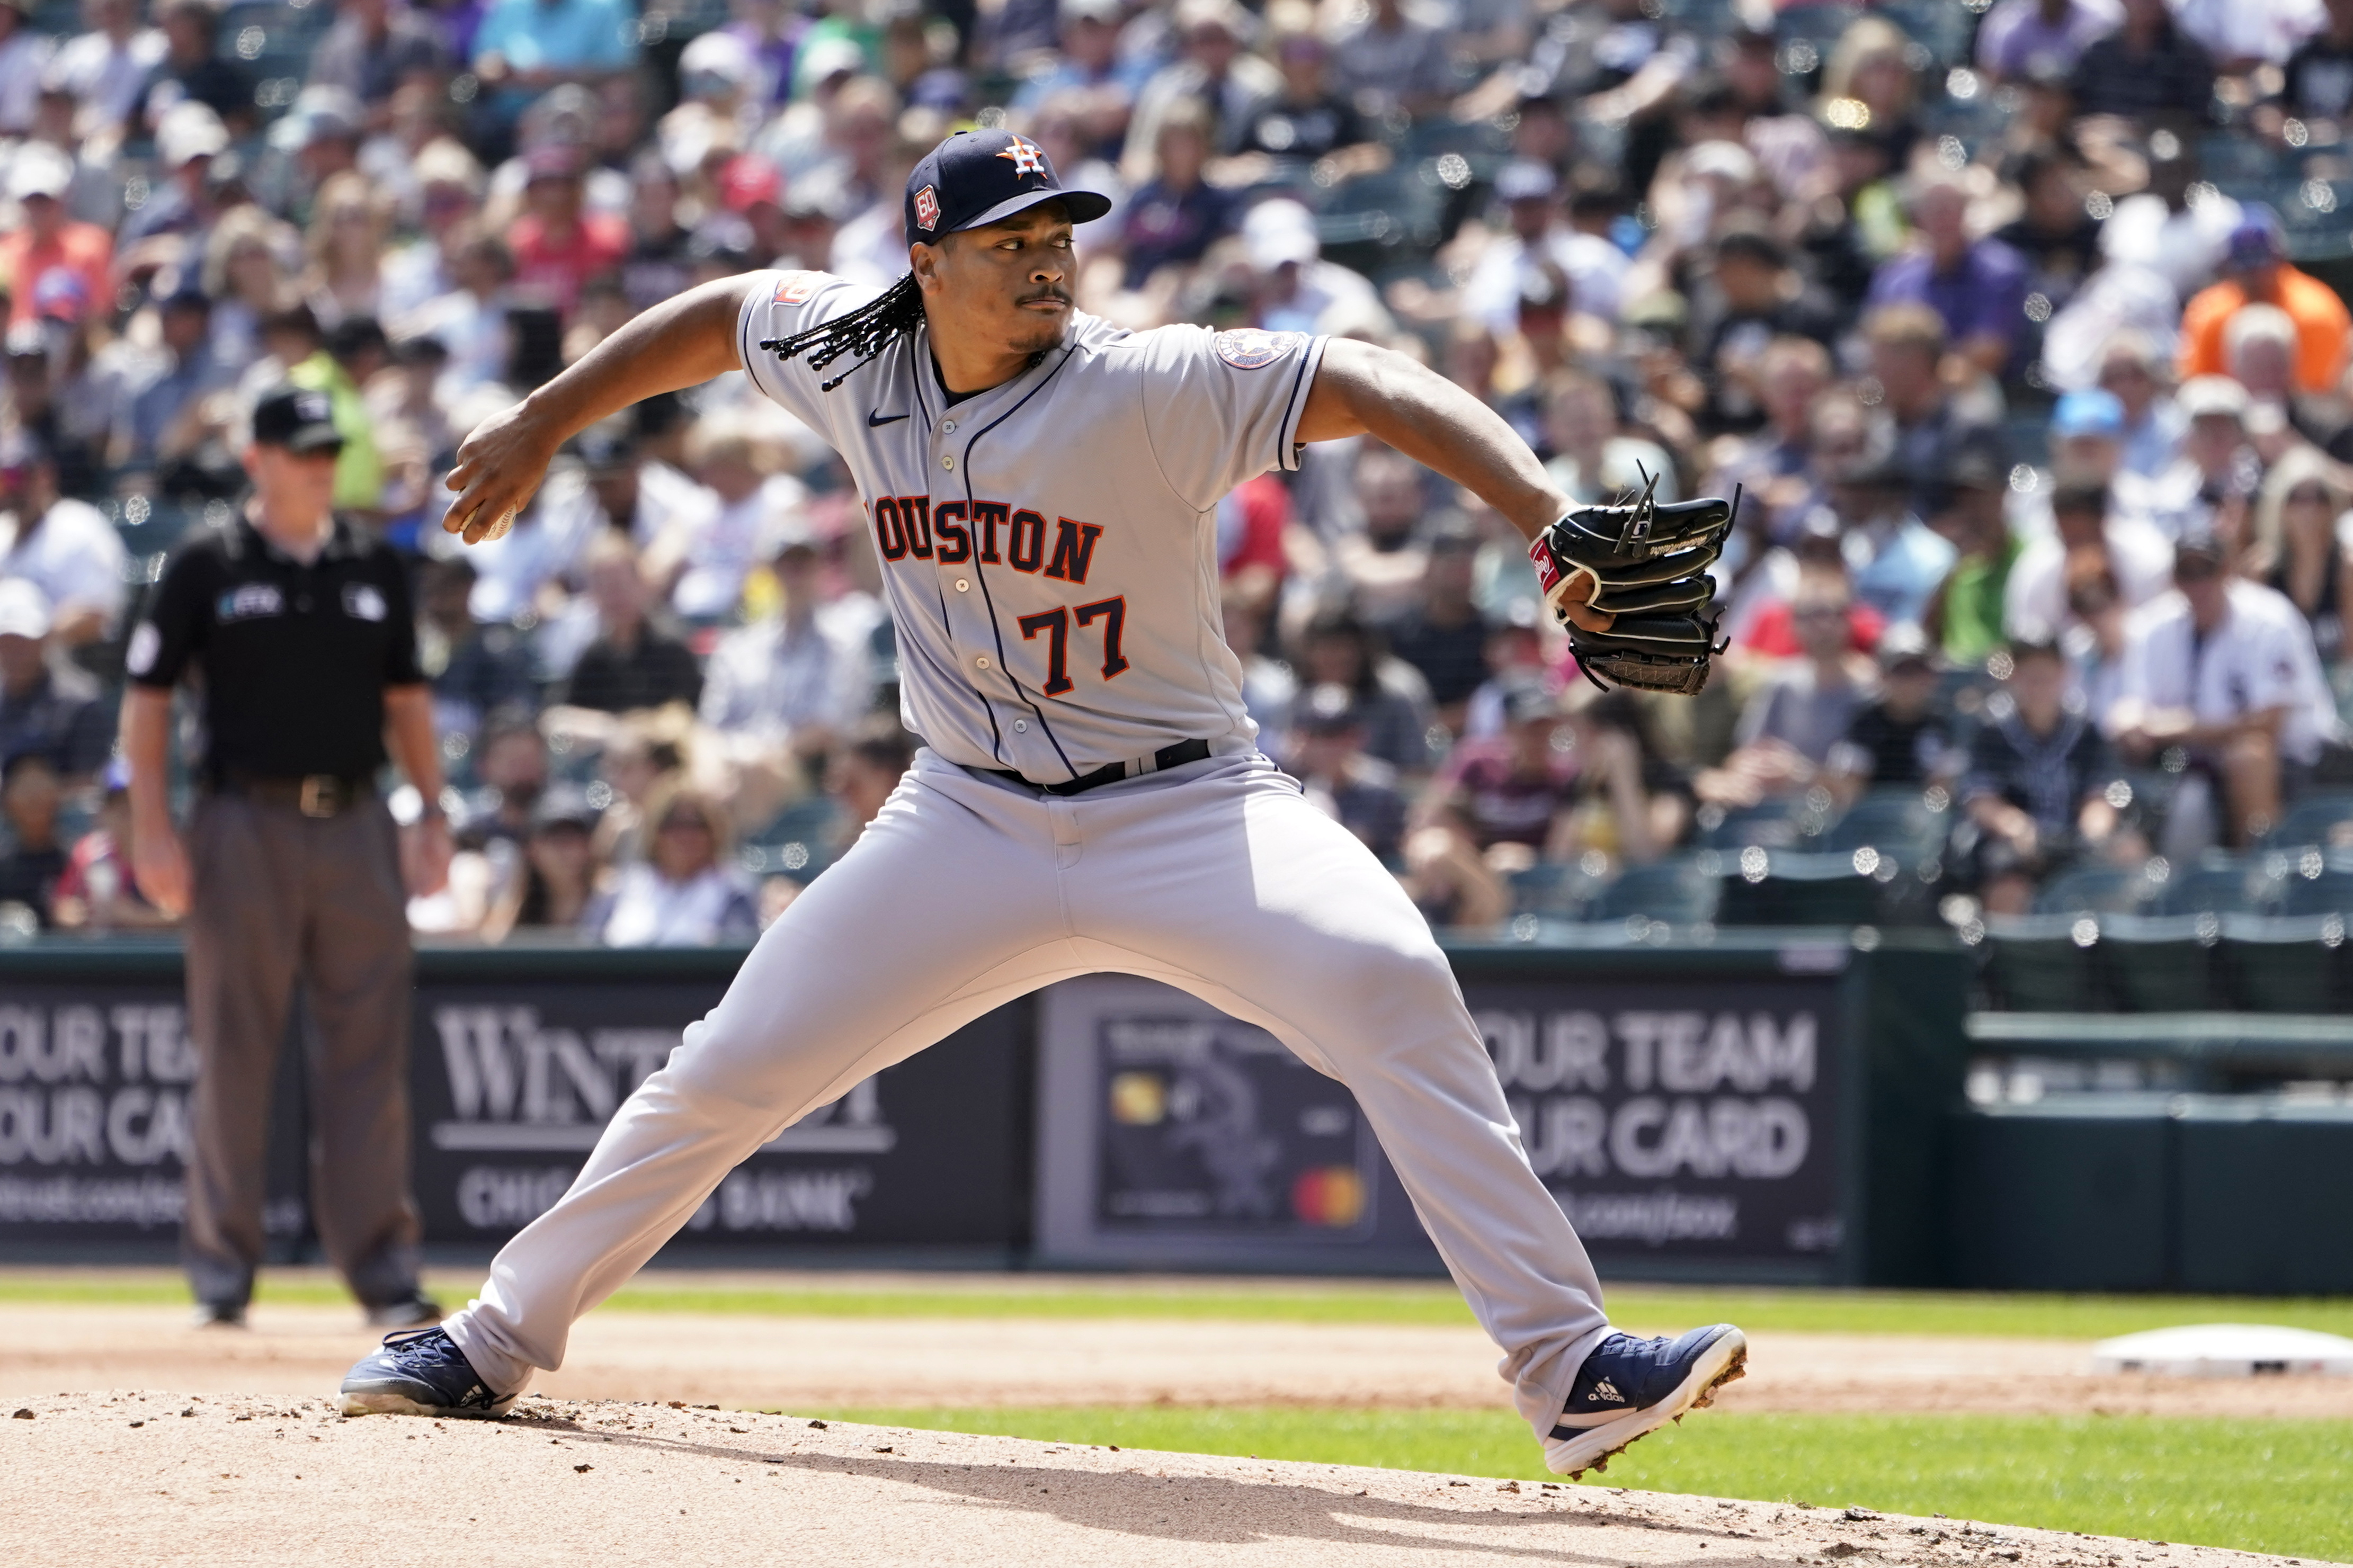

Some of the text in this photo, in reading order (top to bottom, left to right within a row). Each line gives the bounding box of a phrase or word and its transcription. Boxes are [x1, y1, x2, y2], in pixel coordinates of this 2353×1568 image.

[917, 191, 935, 217] 60
[864, 495, 1103, 585] OUSTON
[1017, 595, 1130, 698] 77
[1613, 1010, 1819, 1092] TEAM
[1610, 1096, 1810, 1179] CARD
